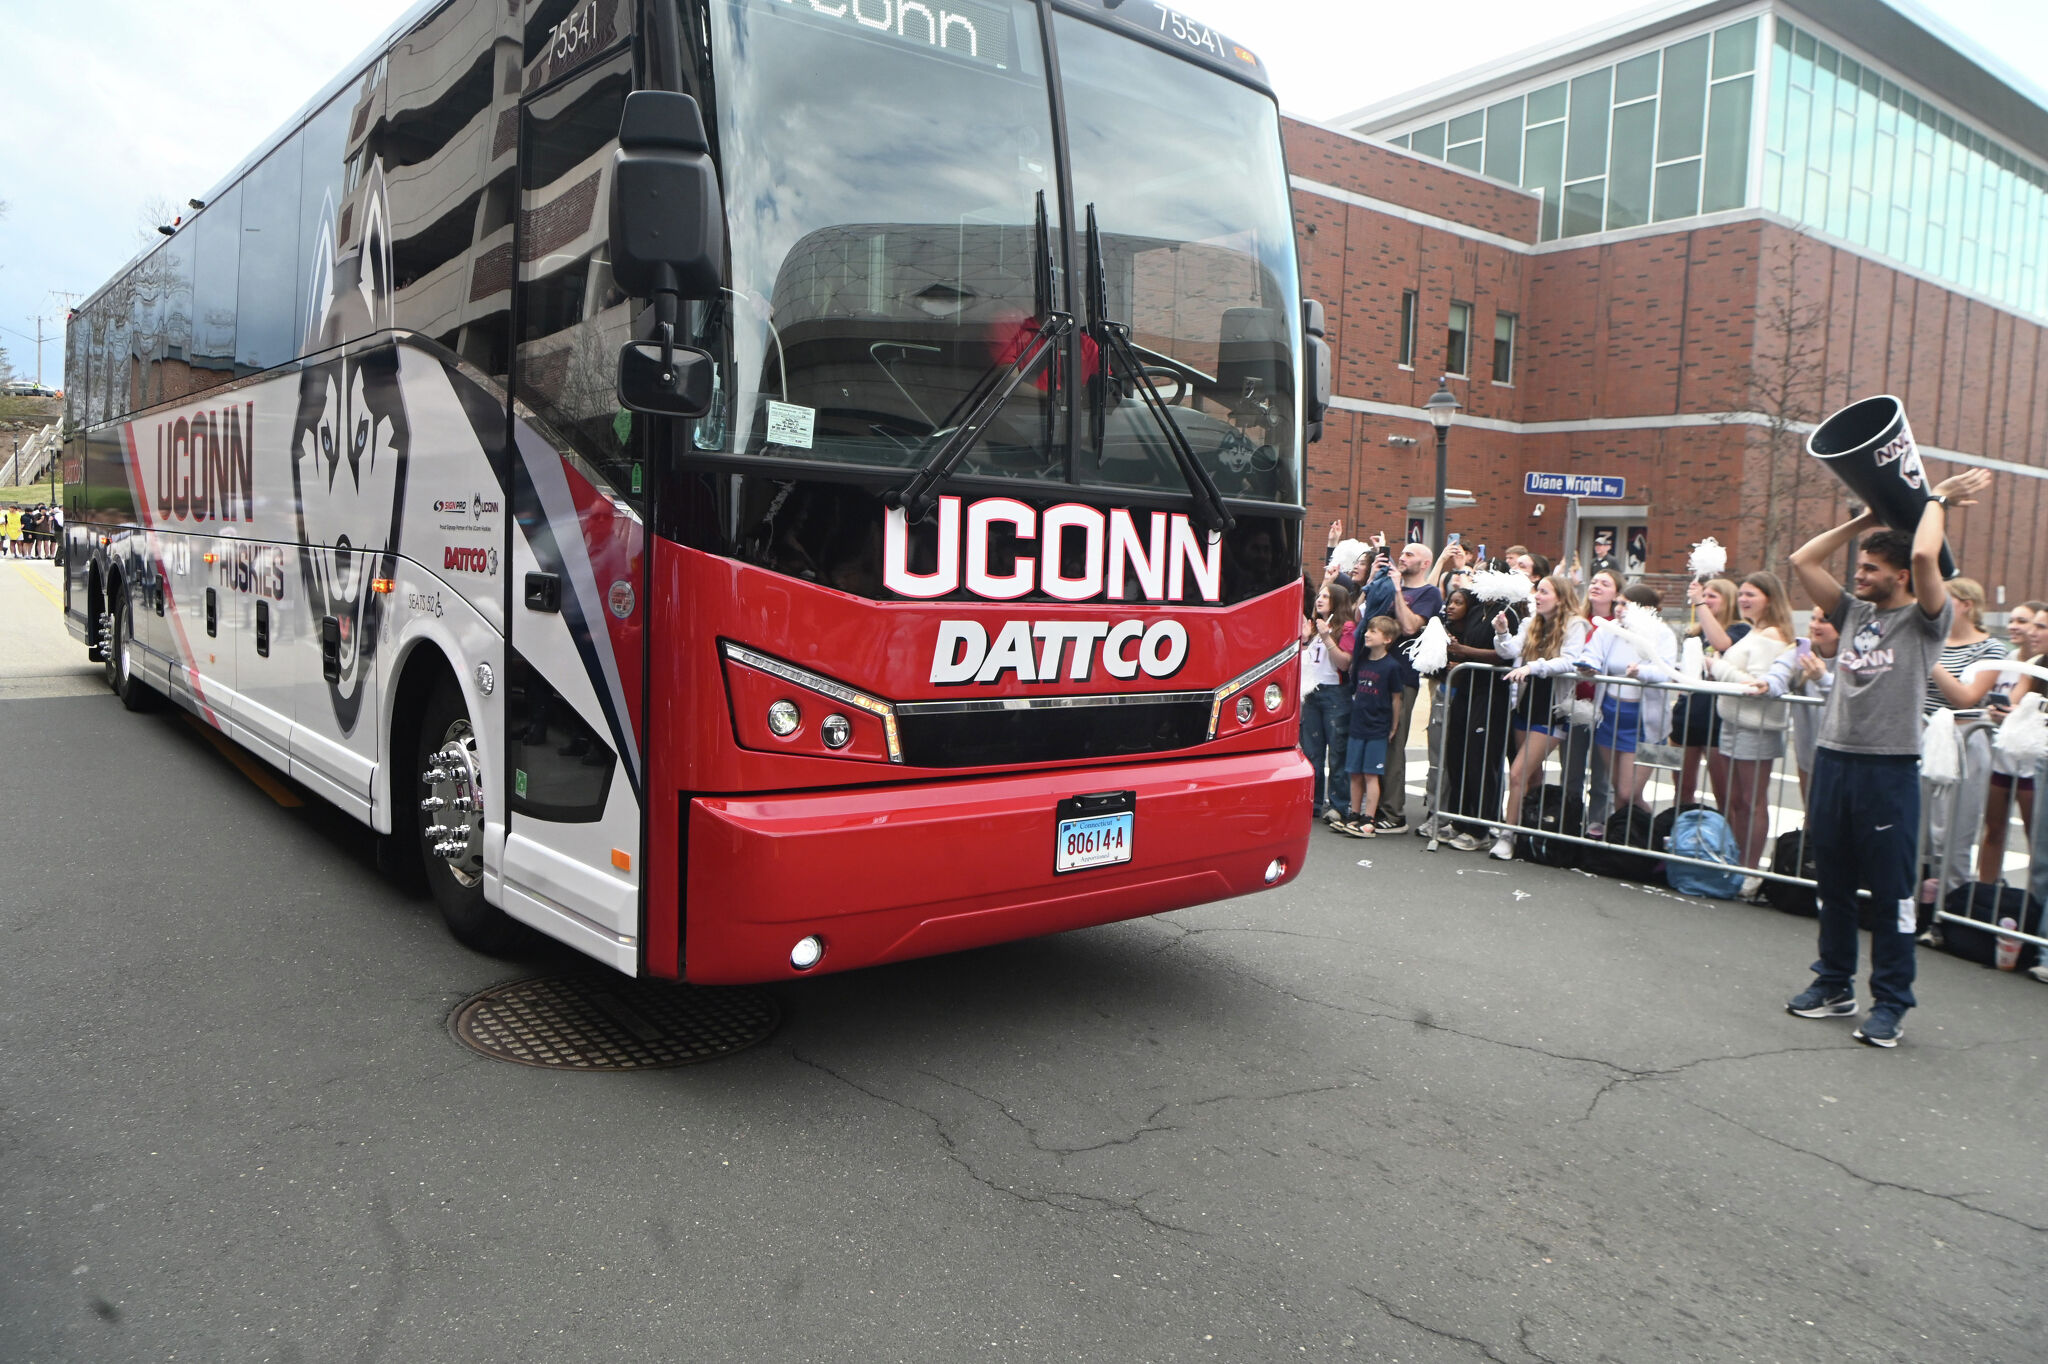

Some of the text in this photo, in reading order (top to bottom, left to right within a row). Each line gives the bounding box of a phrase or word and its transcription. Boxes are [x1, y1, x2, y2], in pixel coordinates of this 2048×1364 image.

[548, 1, 598, 65] 75541
[1153, 3, 1225, 57] 75541
[158, 400, 254, 523] UCONN
[1531, 474, 1618, 496] Diane Wright Way
[481, 502, 499, 513] UCONN
[219, 542, 284, 601] HUSKIES
[444, 546, 487, 573] DATTCO
[883, 495, 1223, 601] UCONN
[409, 593, 426, 611] SEATS
[929, 619, 1190, 687] DATTCO
[1080, 820, 1113, 830] Connecticut
